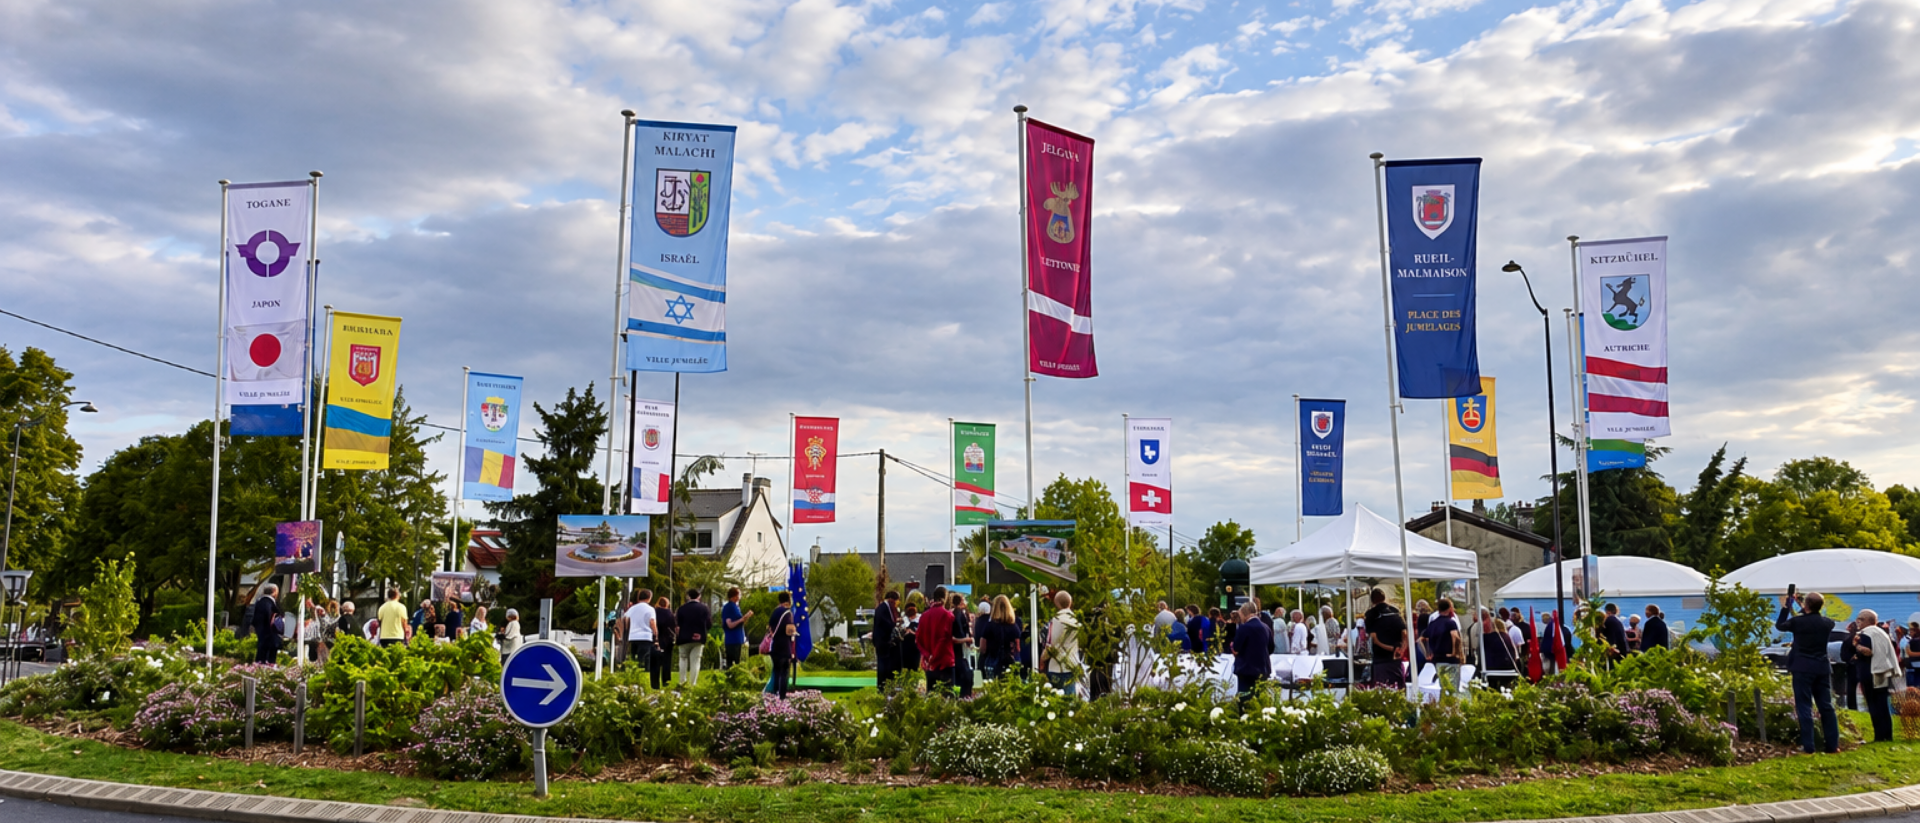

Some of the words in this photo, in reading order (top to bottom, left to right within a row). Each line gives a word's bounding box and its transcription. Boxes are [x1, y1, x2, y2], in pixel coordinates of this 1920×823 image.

[663, 131, 710, 143] KIRYAT
[654, 145, 716, 159] MALACHI
[246, 198, 291, 209] TOGANE
[1414, 253, 1455, 264] RUEIL-
[1040, 256, 1081, 273] LETTONIE
[1397, 267, 1468, 278] MALMAISON
[251, 299, 281, 309] JAPON
[1407, 310, 1440, 319] PLACE
[1442, 309, 1461, 319] DES
[1405, 322, 1461, 334] JUMELAGES
[1603, 343, 1651, 352] AUTRICHE
[645, 356, 670, 364] VILLE
